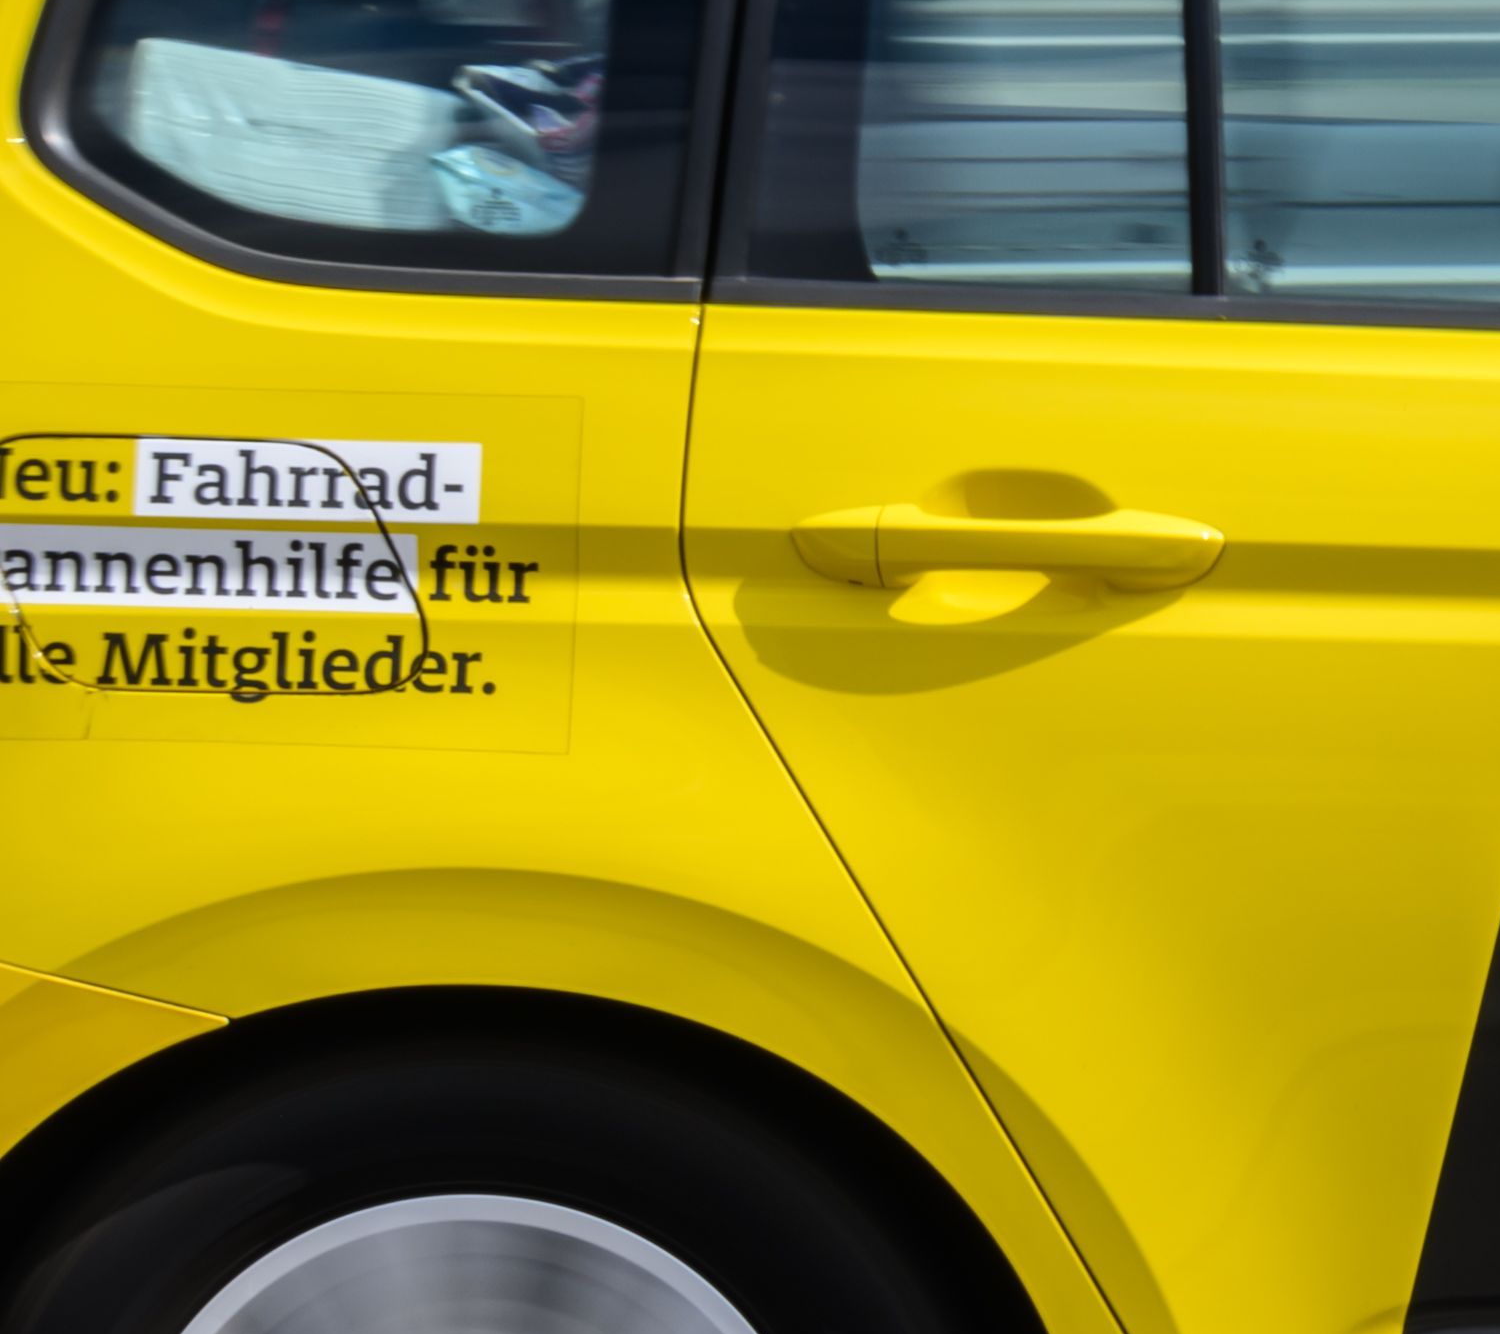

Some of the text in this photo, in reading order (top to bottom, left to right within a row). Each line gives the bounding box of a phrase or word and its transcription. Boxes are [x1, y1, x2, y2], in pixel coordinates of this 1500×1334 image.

[149, 450, 464, 511] Fahrrad-
[428, 543, 540, 604] für
[96, 626, 497, 703] Mitglieder.
